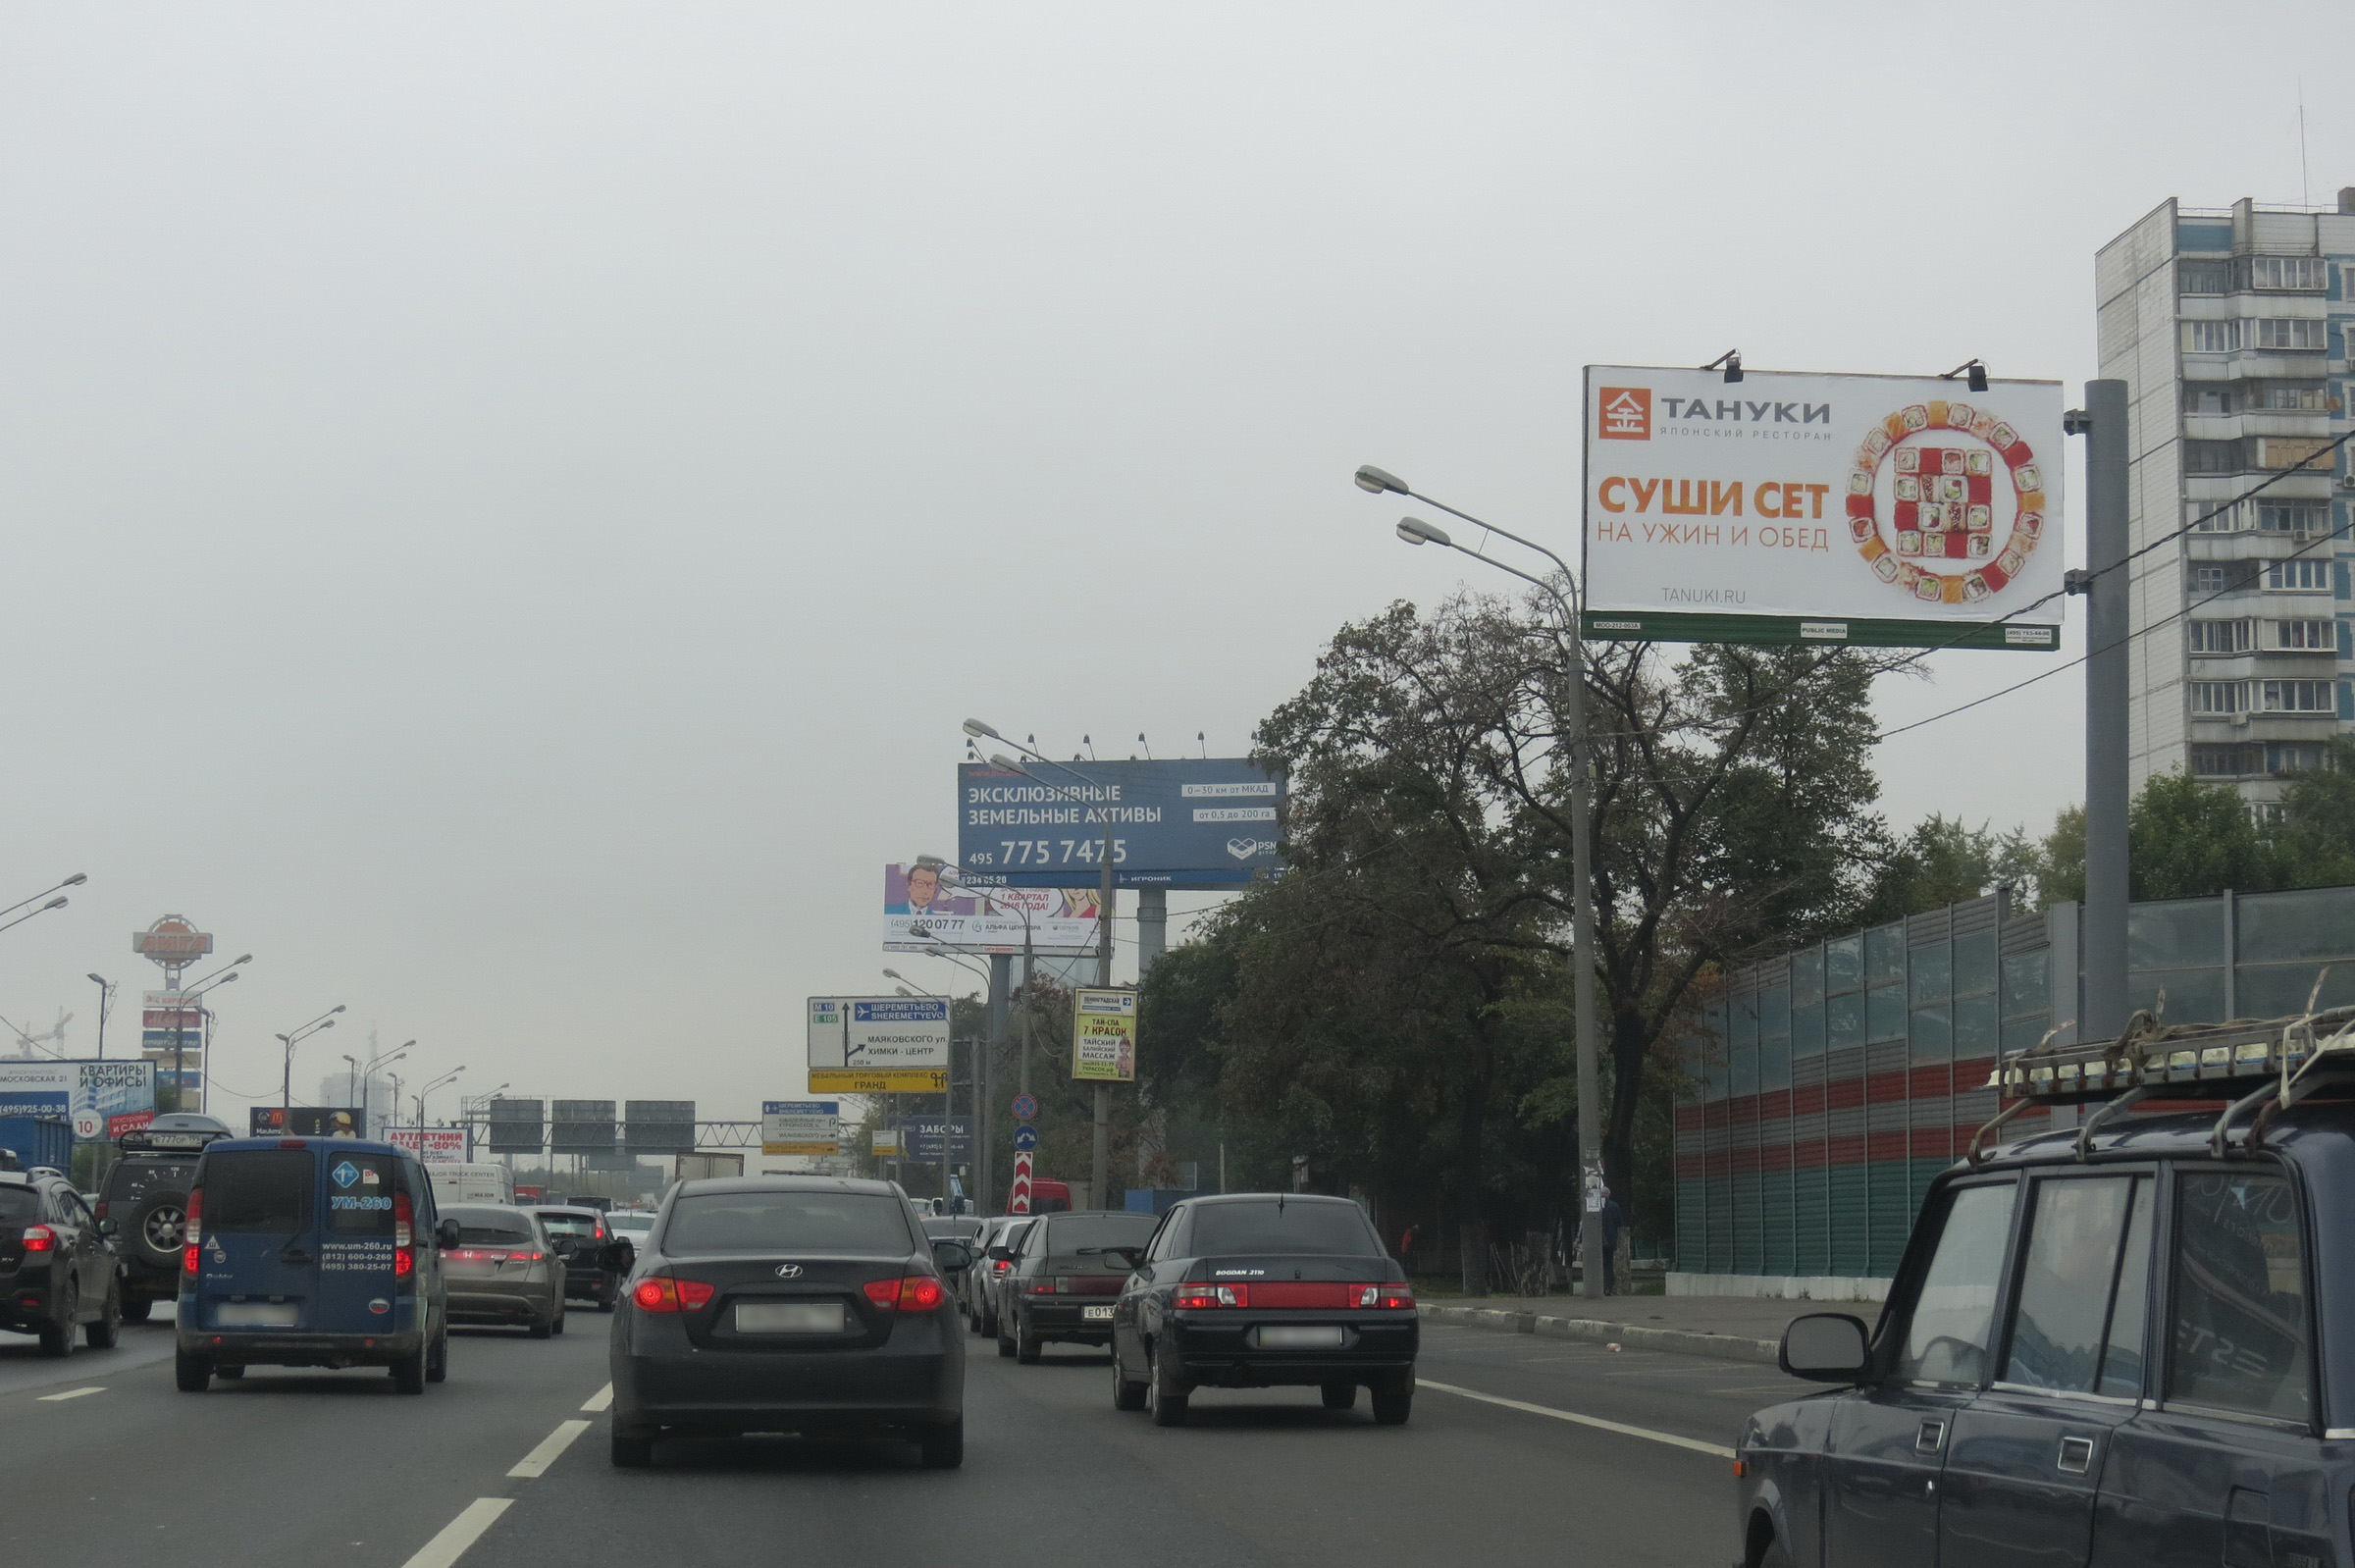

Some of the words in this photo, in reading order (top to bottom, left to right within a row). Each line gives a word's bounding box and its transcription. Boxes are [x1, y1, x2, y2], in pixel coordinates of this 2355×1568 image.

[1660, 397, 1830, 424] ТАНУКИ
[1660, 427, 1743, 438] ЯПОНСКИЙ
[1753, 430, 1831, 441] РЕСТОРАН
[1598, 476, 1743, 516] СУШИ
[1753, 482, 1830, 519] СЕТ
[1597, 522, 1633, 543] НА
[1643, 523, 1719, 546] УЖИН
[1731, 526, 1748, 546] И
[1758, 527, 1829, 552] ОБЕД
[1662, 588, 1746, 603] TANUKI.RU
[968, 786, 1121, 804] ЭКСКЛЮЗИВНЫЕ
[1241, 785, 1269, 795] МКАД
[968, 809, 1079, 825] ЗЕМЕЛЬНЫЕ
[1085, 807, 1161, 823] АКТИВЫ
[1211, 810, 1225, 819] 0,5
[1241, 810, 1258, 818] 200
[969, 853, 993, 864] 495
[1001, 840, 1050, 864] 775
[1060, 839, 1126, 863] 7475
[996, 875, 1007, 884] 20
[913, 919, 933, 929] 120
[935, 919, 948, 929] 07
[949, 919, 965, 929] 77
[871, 1003, 939, 1012] ШЕРЕМЕТЬЕВО
[1092, 1026, 1126, 1036] КРАСОК
[1083, 1037, 1116, 1046] ТАЙСКИЙ
[80, 1066, 146, 1077] КВАРТИРЫ
[80, 1077, 88, 1087] И
[93, 1076, 146, 1087] ОФИСЫ
[855, 1081, 887, 1090] ГРАНД
[391, 1132, 462, 1141] АУТЛЕТНИЙ
[332, 1196, 392, 1210] УМ-260
